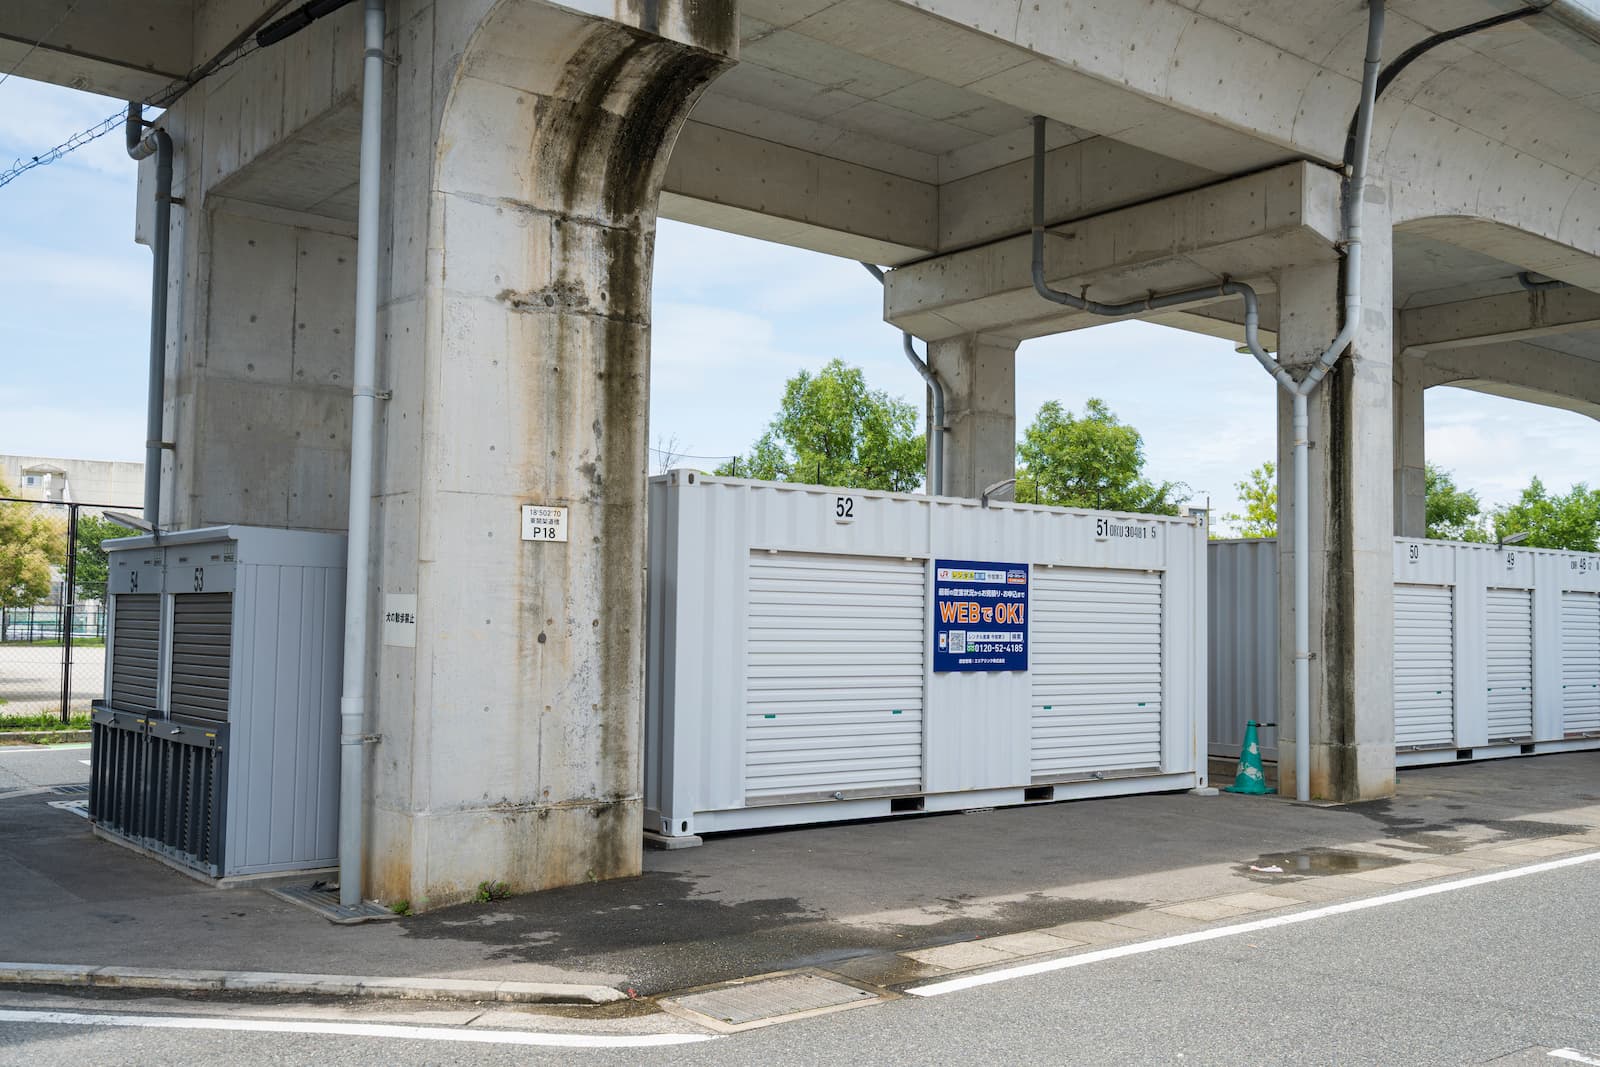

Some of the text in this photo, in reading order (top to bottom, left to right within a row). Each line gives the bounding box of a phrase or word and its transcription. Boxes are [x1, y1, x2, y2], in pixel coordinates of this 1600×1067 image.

[836, 497, 853, 518] 52
[534, 527, 555, 538] P18
[1096, 518, 1108, 536] 51
[1409, 544, 1419, 559] 50
[1506, 552, 1515, 566] 49
[130, 571, 138, 593] 54
[194, 567, 204, 592] 53
[975, 644, 1023, 653] 0120-52-4185
